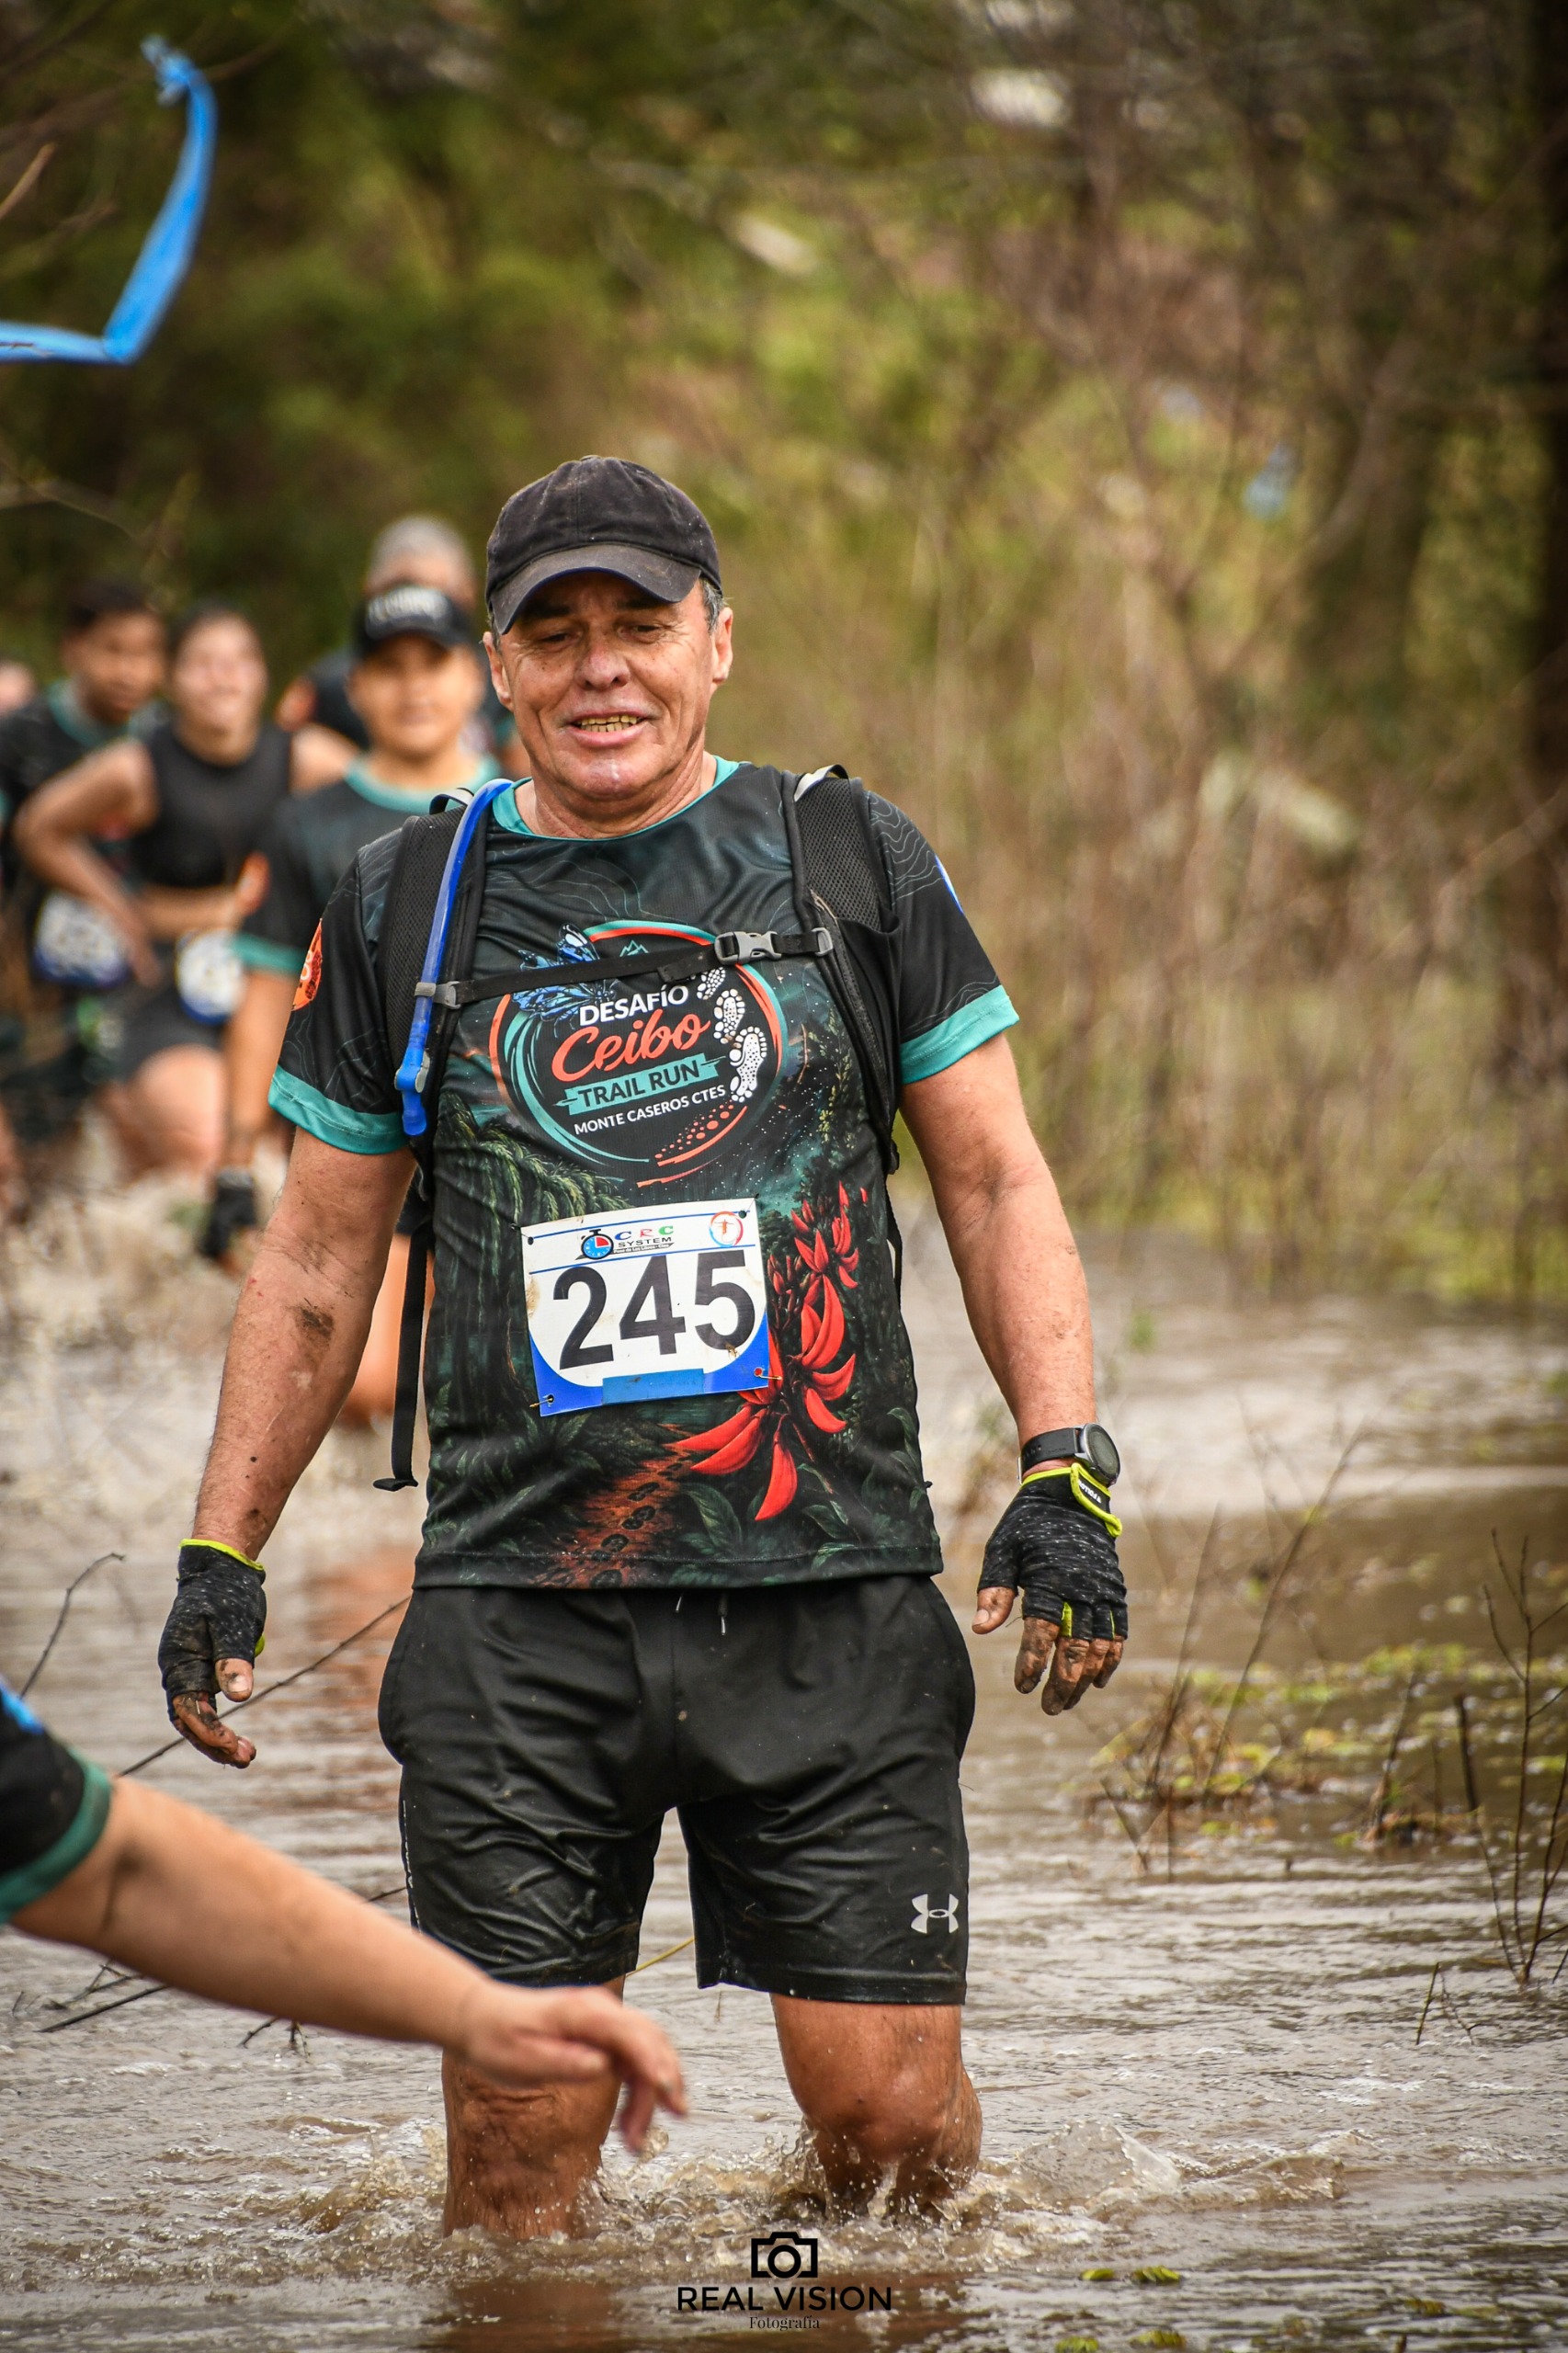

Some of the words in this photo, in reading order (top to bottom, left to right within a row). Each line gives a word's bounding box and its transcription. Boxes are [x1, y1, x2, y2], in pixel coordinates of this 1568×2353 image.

[579, 984, 688, 1026] DESAFÍO
[551, 1008, 710, 1082] Ceibo
[578, 1077, 645, 1108] TRAIL
[649, 1060, 699, 1091] RUN
[574, 1113, 625, 1135] MONTE
[627, 1096, 689, 1122] CASEROS
[691, 1085, 726, 1104] CTES
[619, 1237, 672, 1247] SYSTEM
[552, 1250, 756, 1370] 245
